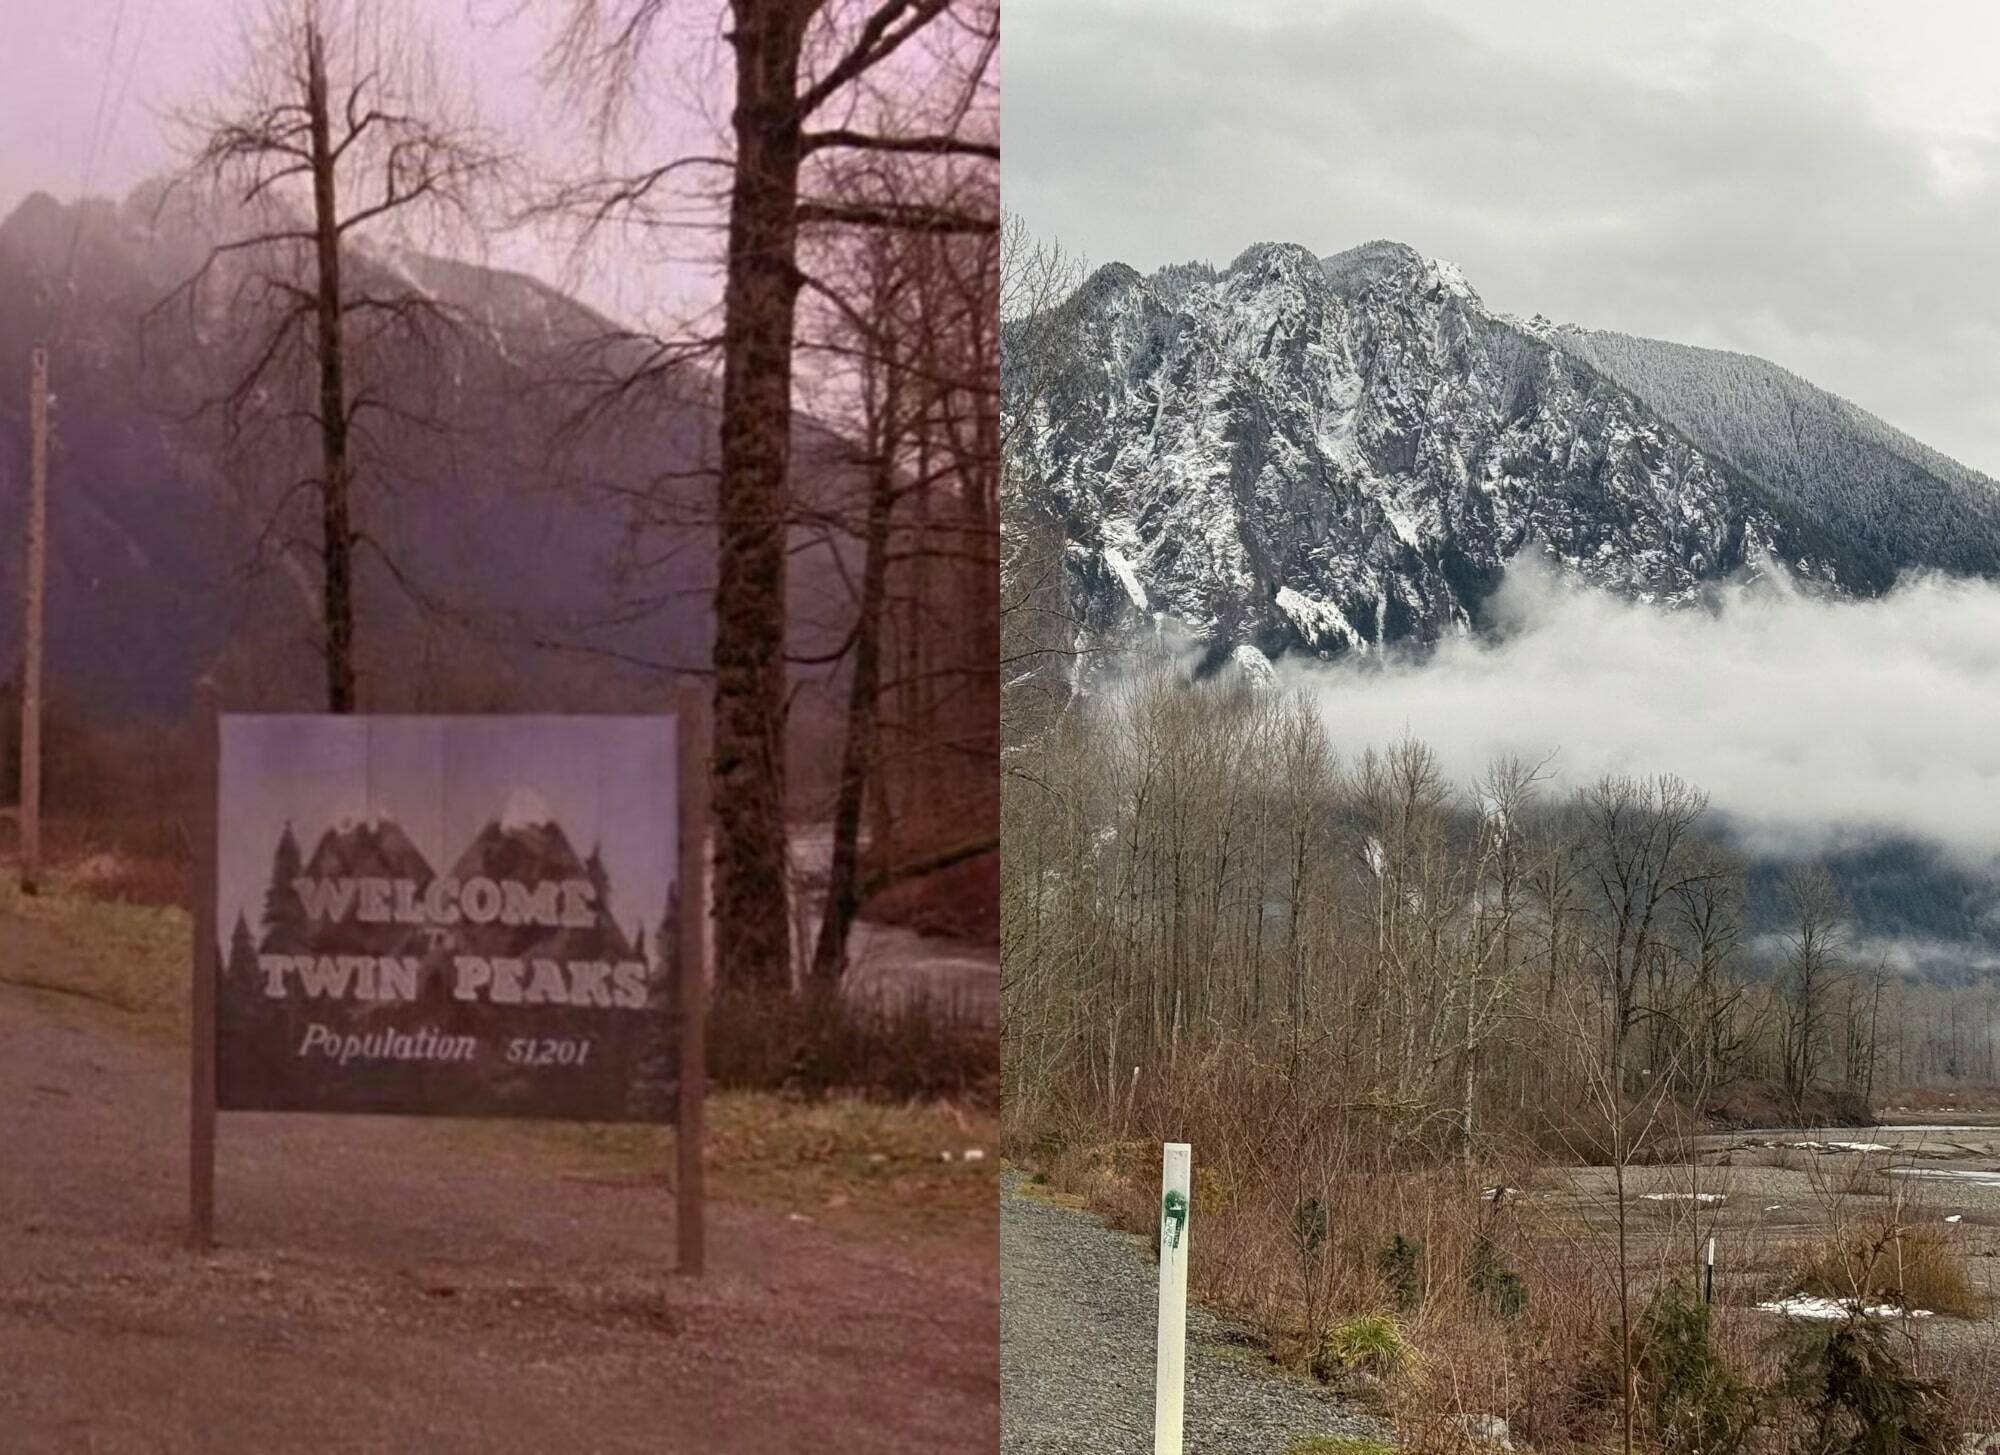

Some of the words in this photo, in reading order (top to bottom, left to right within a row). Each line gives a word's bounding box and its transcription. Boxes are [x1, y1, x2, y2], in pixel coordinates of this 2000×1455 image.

[293, 877, 597, 927] WELCOME
[259, 954, 419, 1001] TWIN
[453, 957, 648, 1009] PEAKS
[299, 1024, 477, 1064] Population
